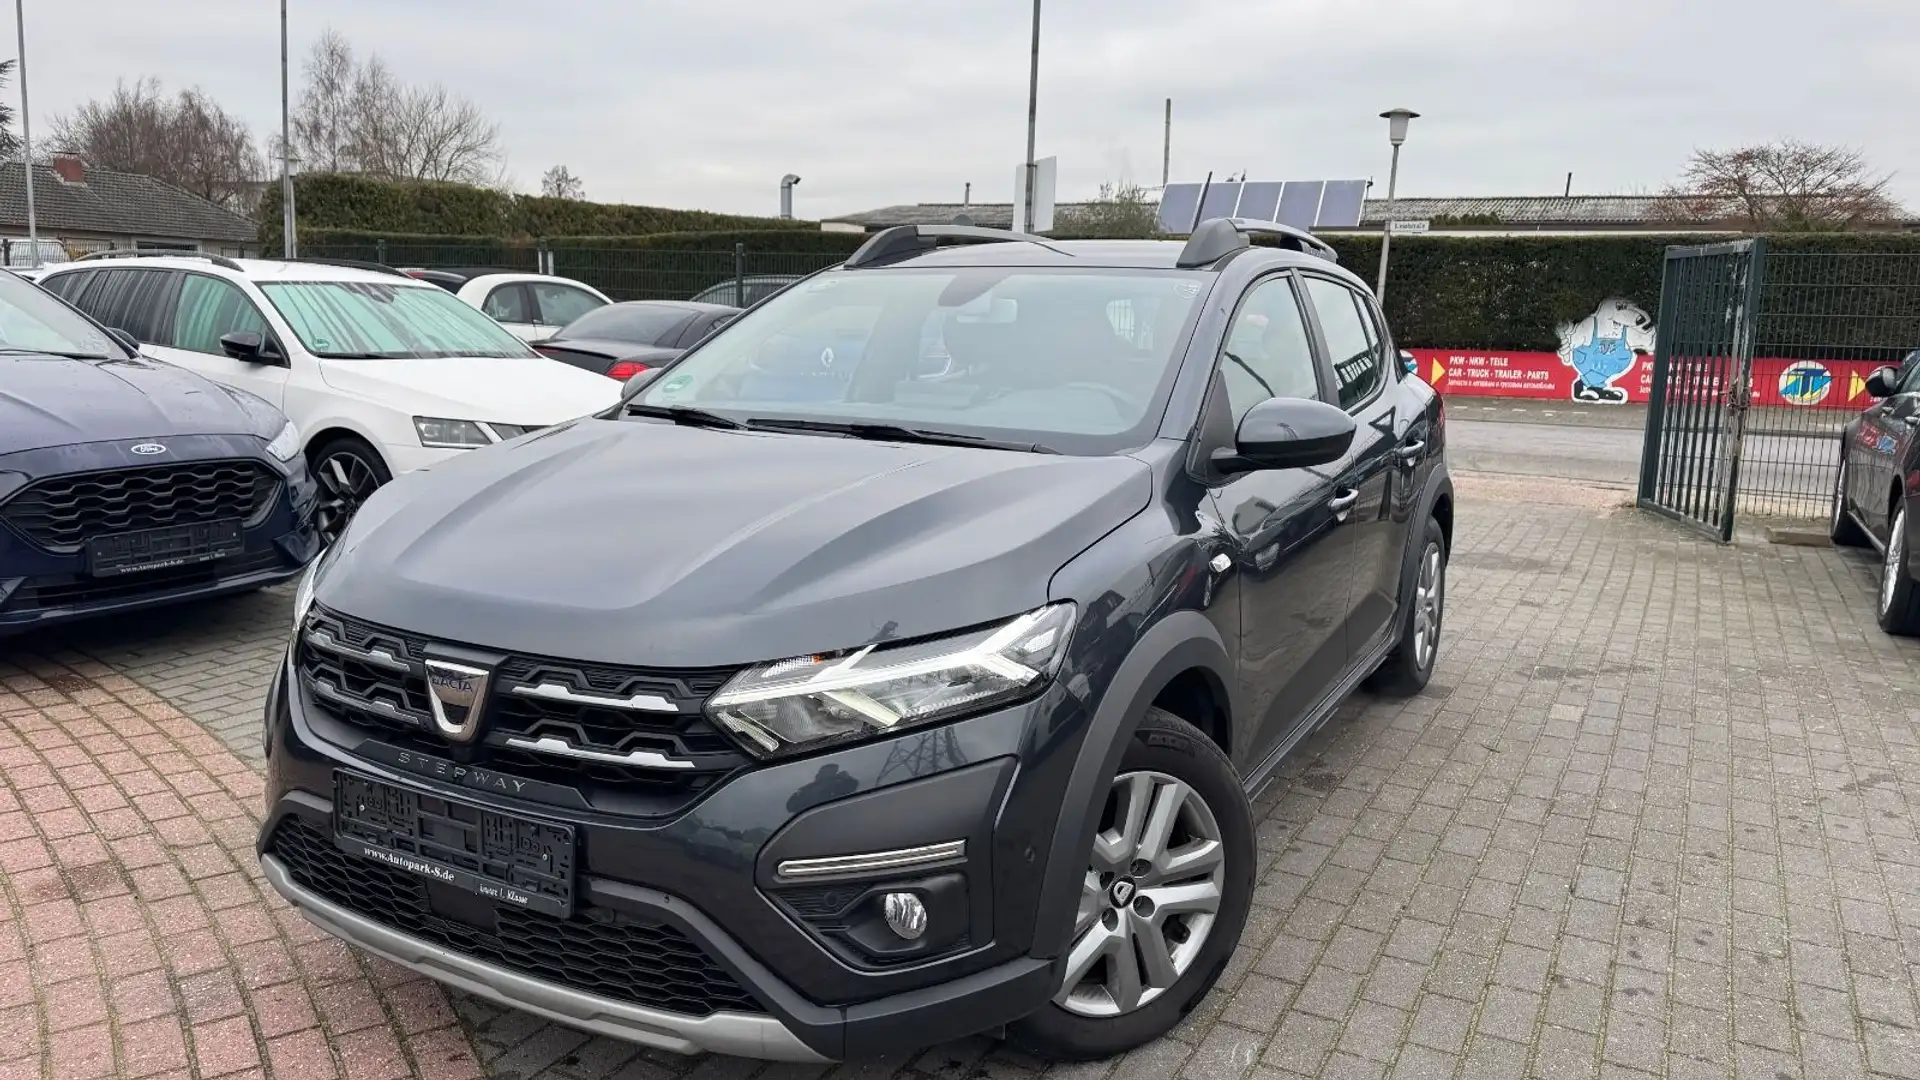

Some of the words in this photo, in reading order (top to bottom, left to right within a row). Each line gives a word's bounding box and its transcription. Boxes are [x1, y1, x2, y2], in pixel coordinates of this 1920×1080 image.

[1449, 355, 1465, 365] PKW
[1469, 356, 1486, 366] NKW
[1489, 357, 1509, 367] TEILE
[1448, 368, 1462, 377] CAR
[1467, 368, 1489, 378] TRUCK
[1494, 369, 1522, 379] TRAILER
[1526, 370, 1549, 380] PARTS
[398, 751, 526, 793] STEPWAY
[363, 847, 455, 881] www.Autopark-S.de
